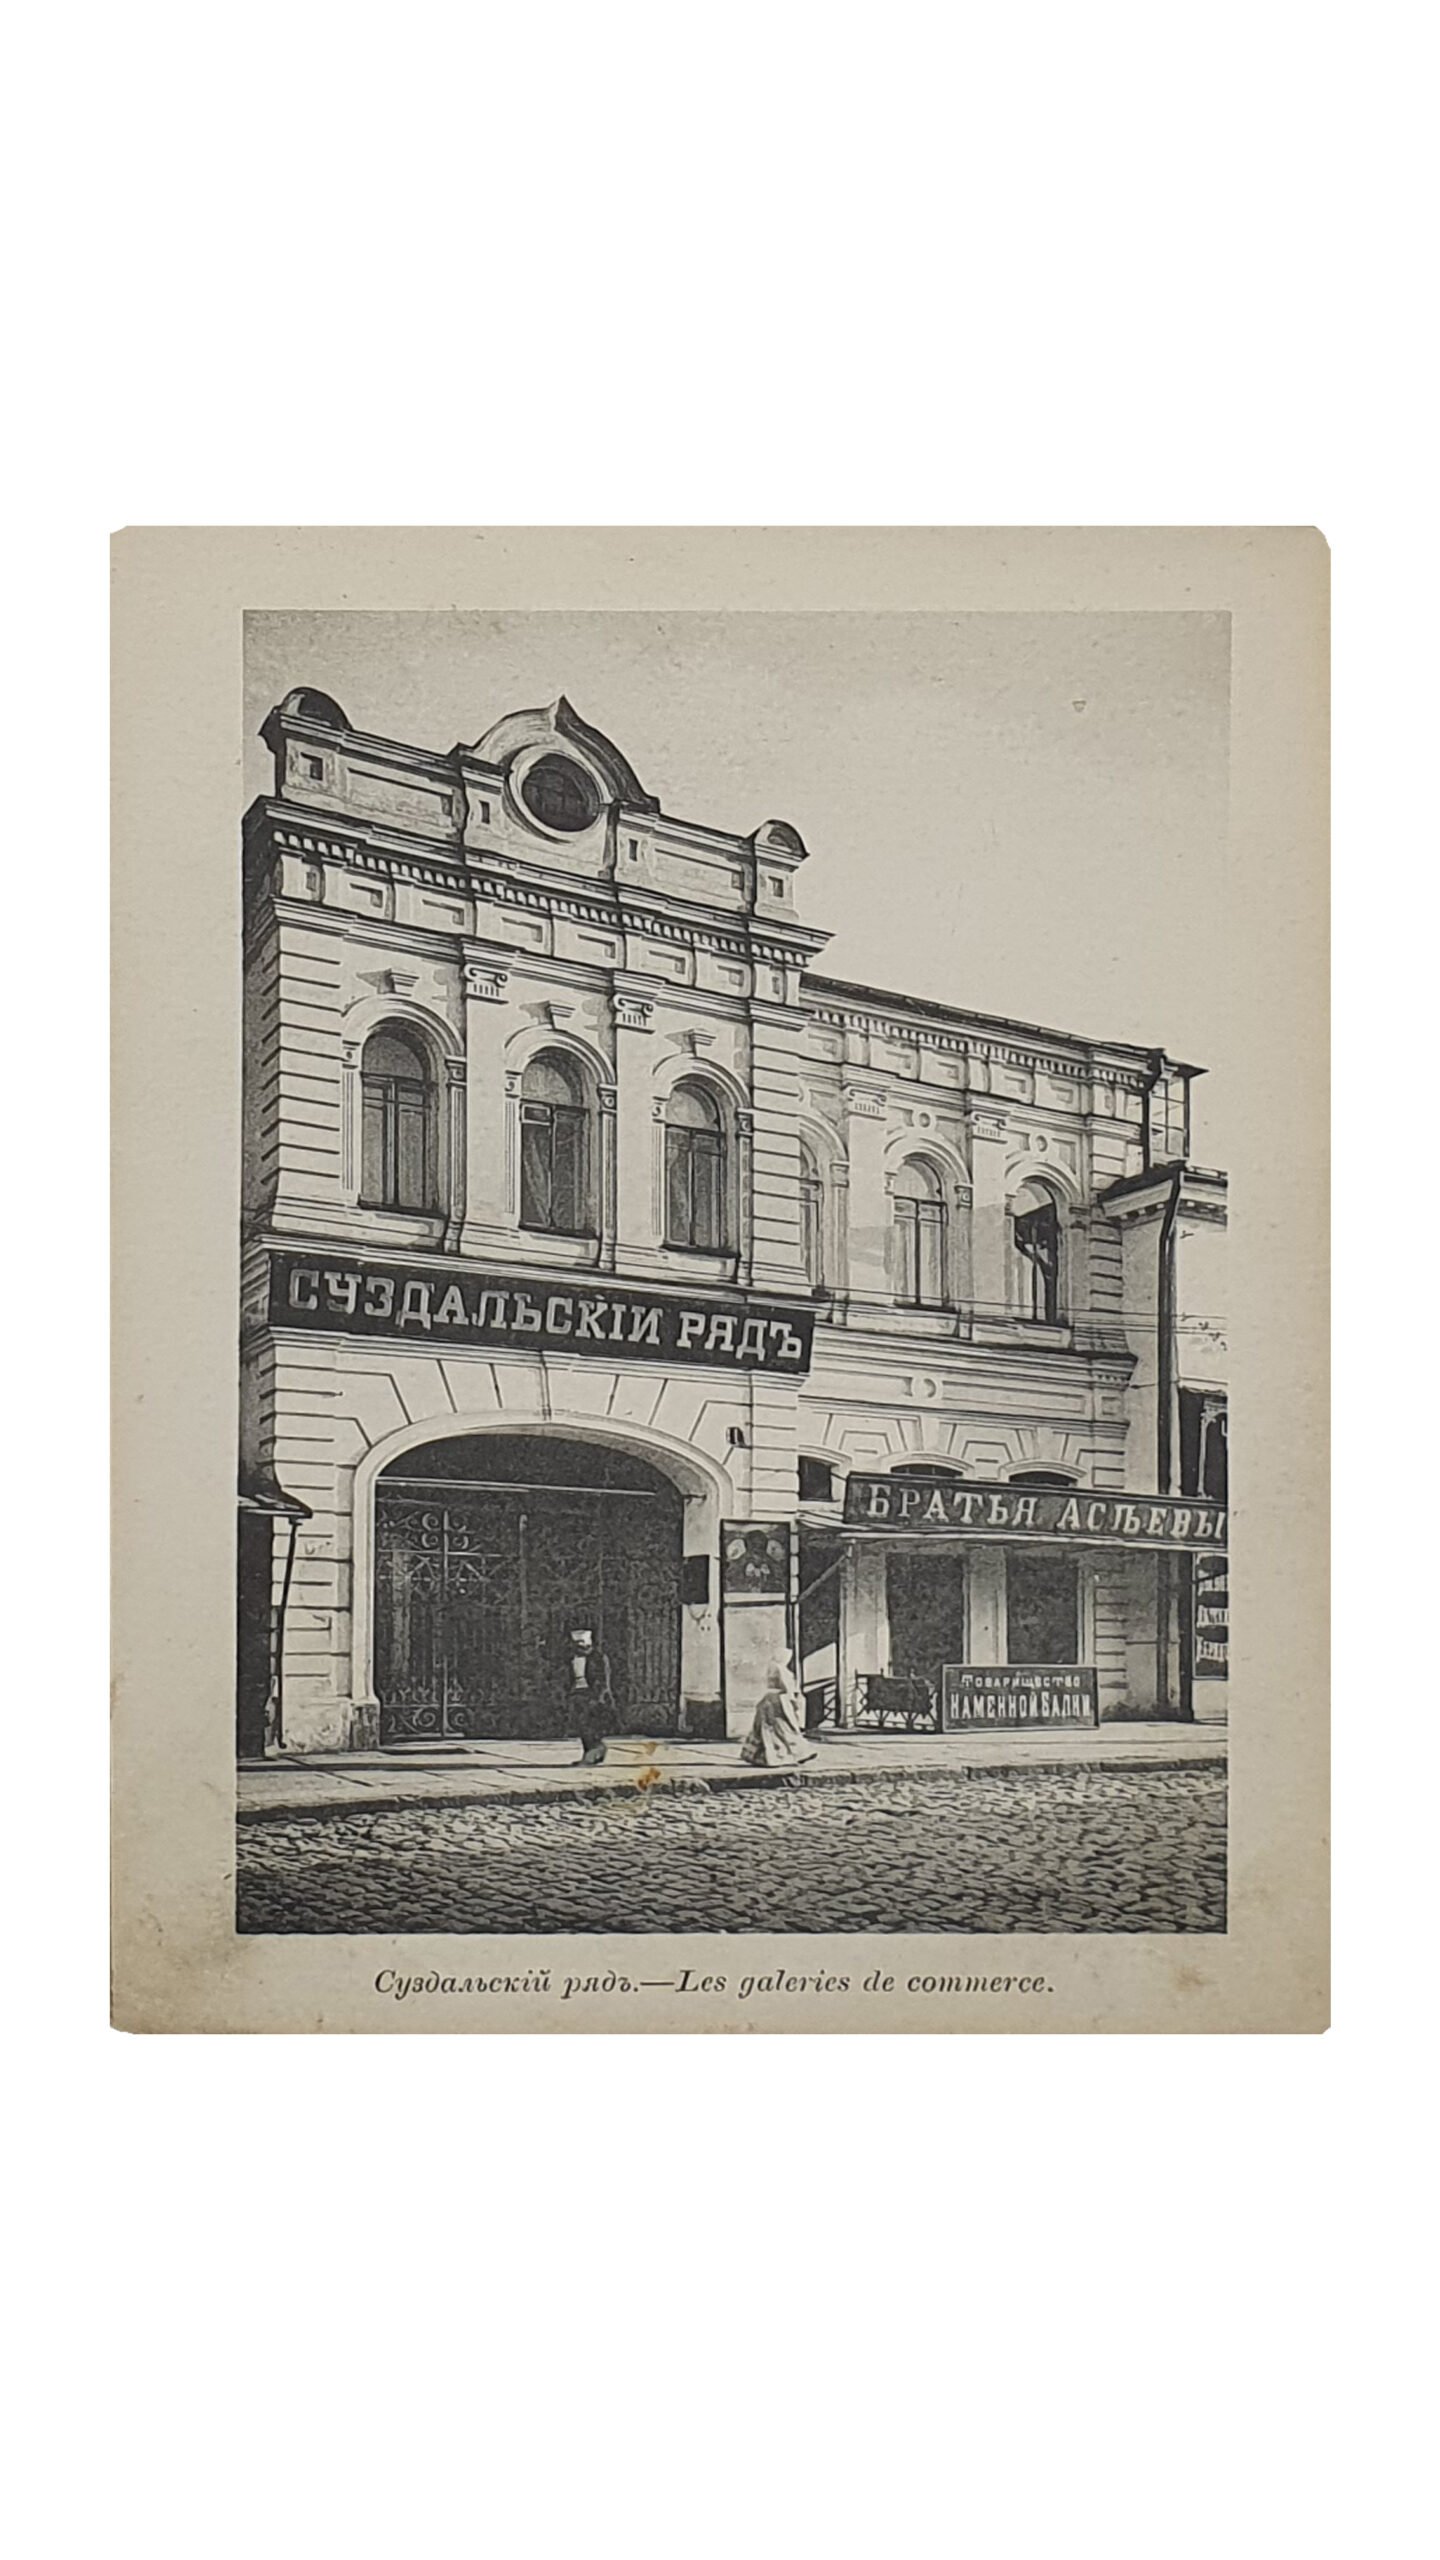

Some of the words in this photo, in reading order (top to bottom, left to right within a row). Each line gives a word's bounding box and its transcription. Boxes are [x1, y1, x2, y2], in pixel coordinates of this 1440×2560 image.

[676, 1310, 803, 1362] РЯДЪ
[866, 1483, 1039, 1527] БРАТЬЯ
[374, 1968, 552, 2000] Суздальскій
[737, 1969, 851, 1999] galeries
[862, 1969, 895, 1993] de
[906, 1975, 1055, 1993] commerce.
